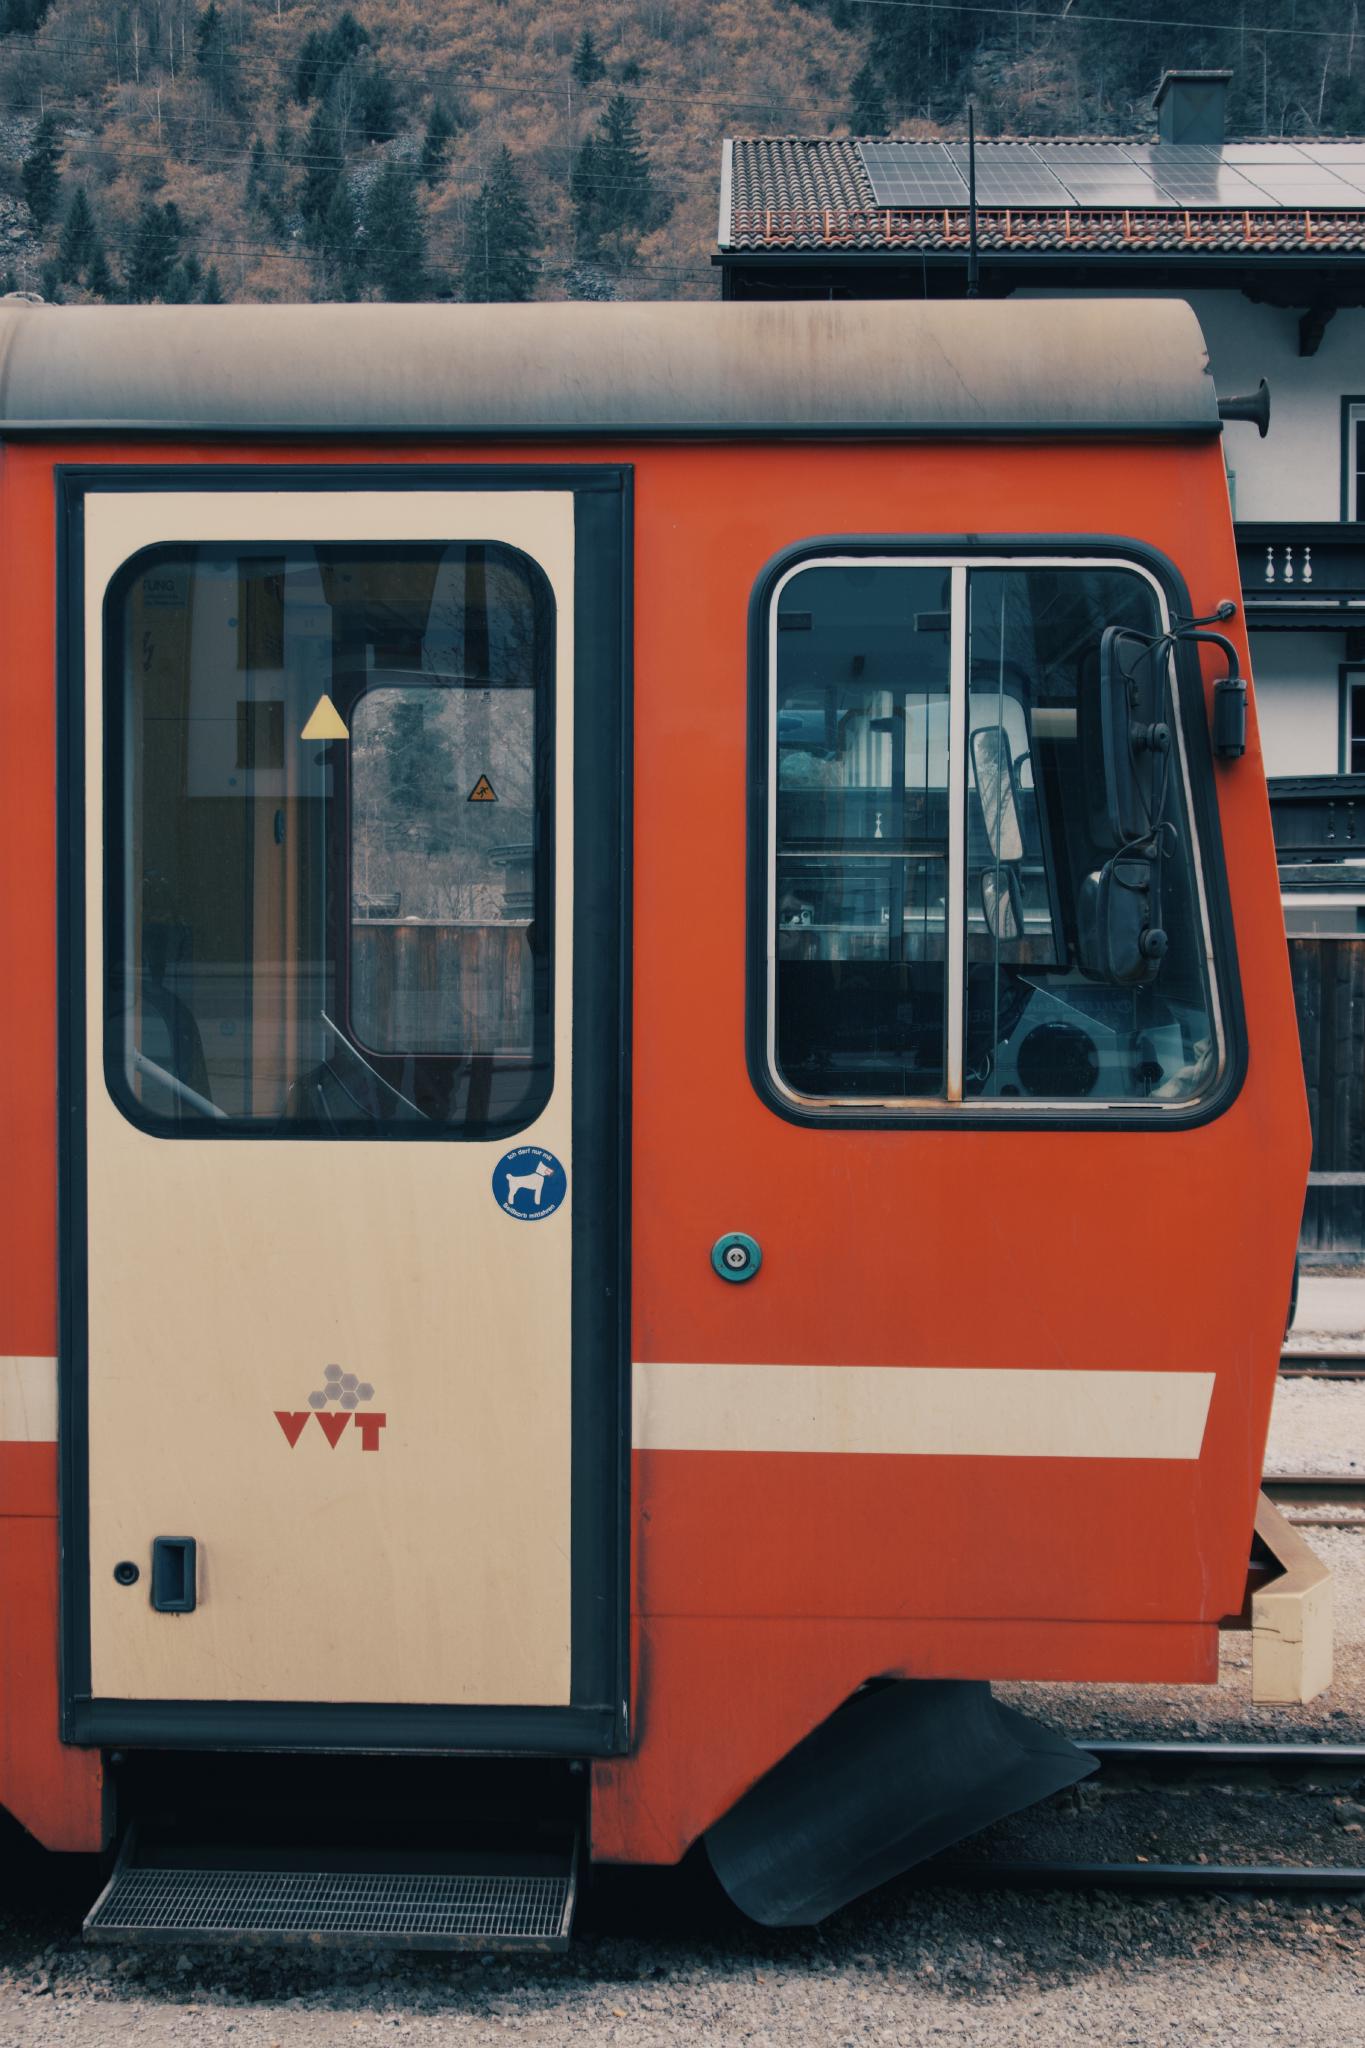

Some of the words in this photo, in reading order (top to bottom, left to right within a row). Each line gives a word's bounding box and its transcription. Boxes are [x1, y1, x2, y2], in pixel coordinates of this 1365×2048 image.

[507, 1152, 517, 1160] Ich
[543, 1153, 553, 1161] mit
[529, 1204, 555, 1219] mitfahren
[273, 1411, 386, 1451] VVT
